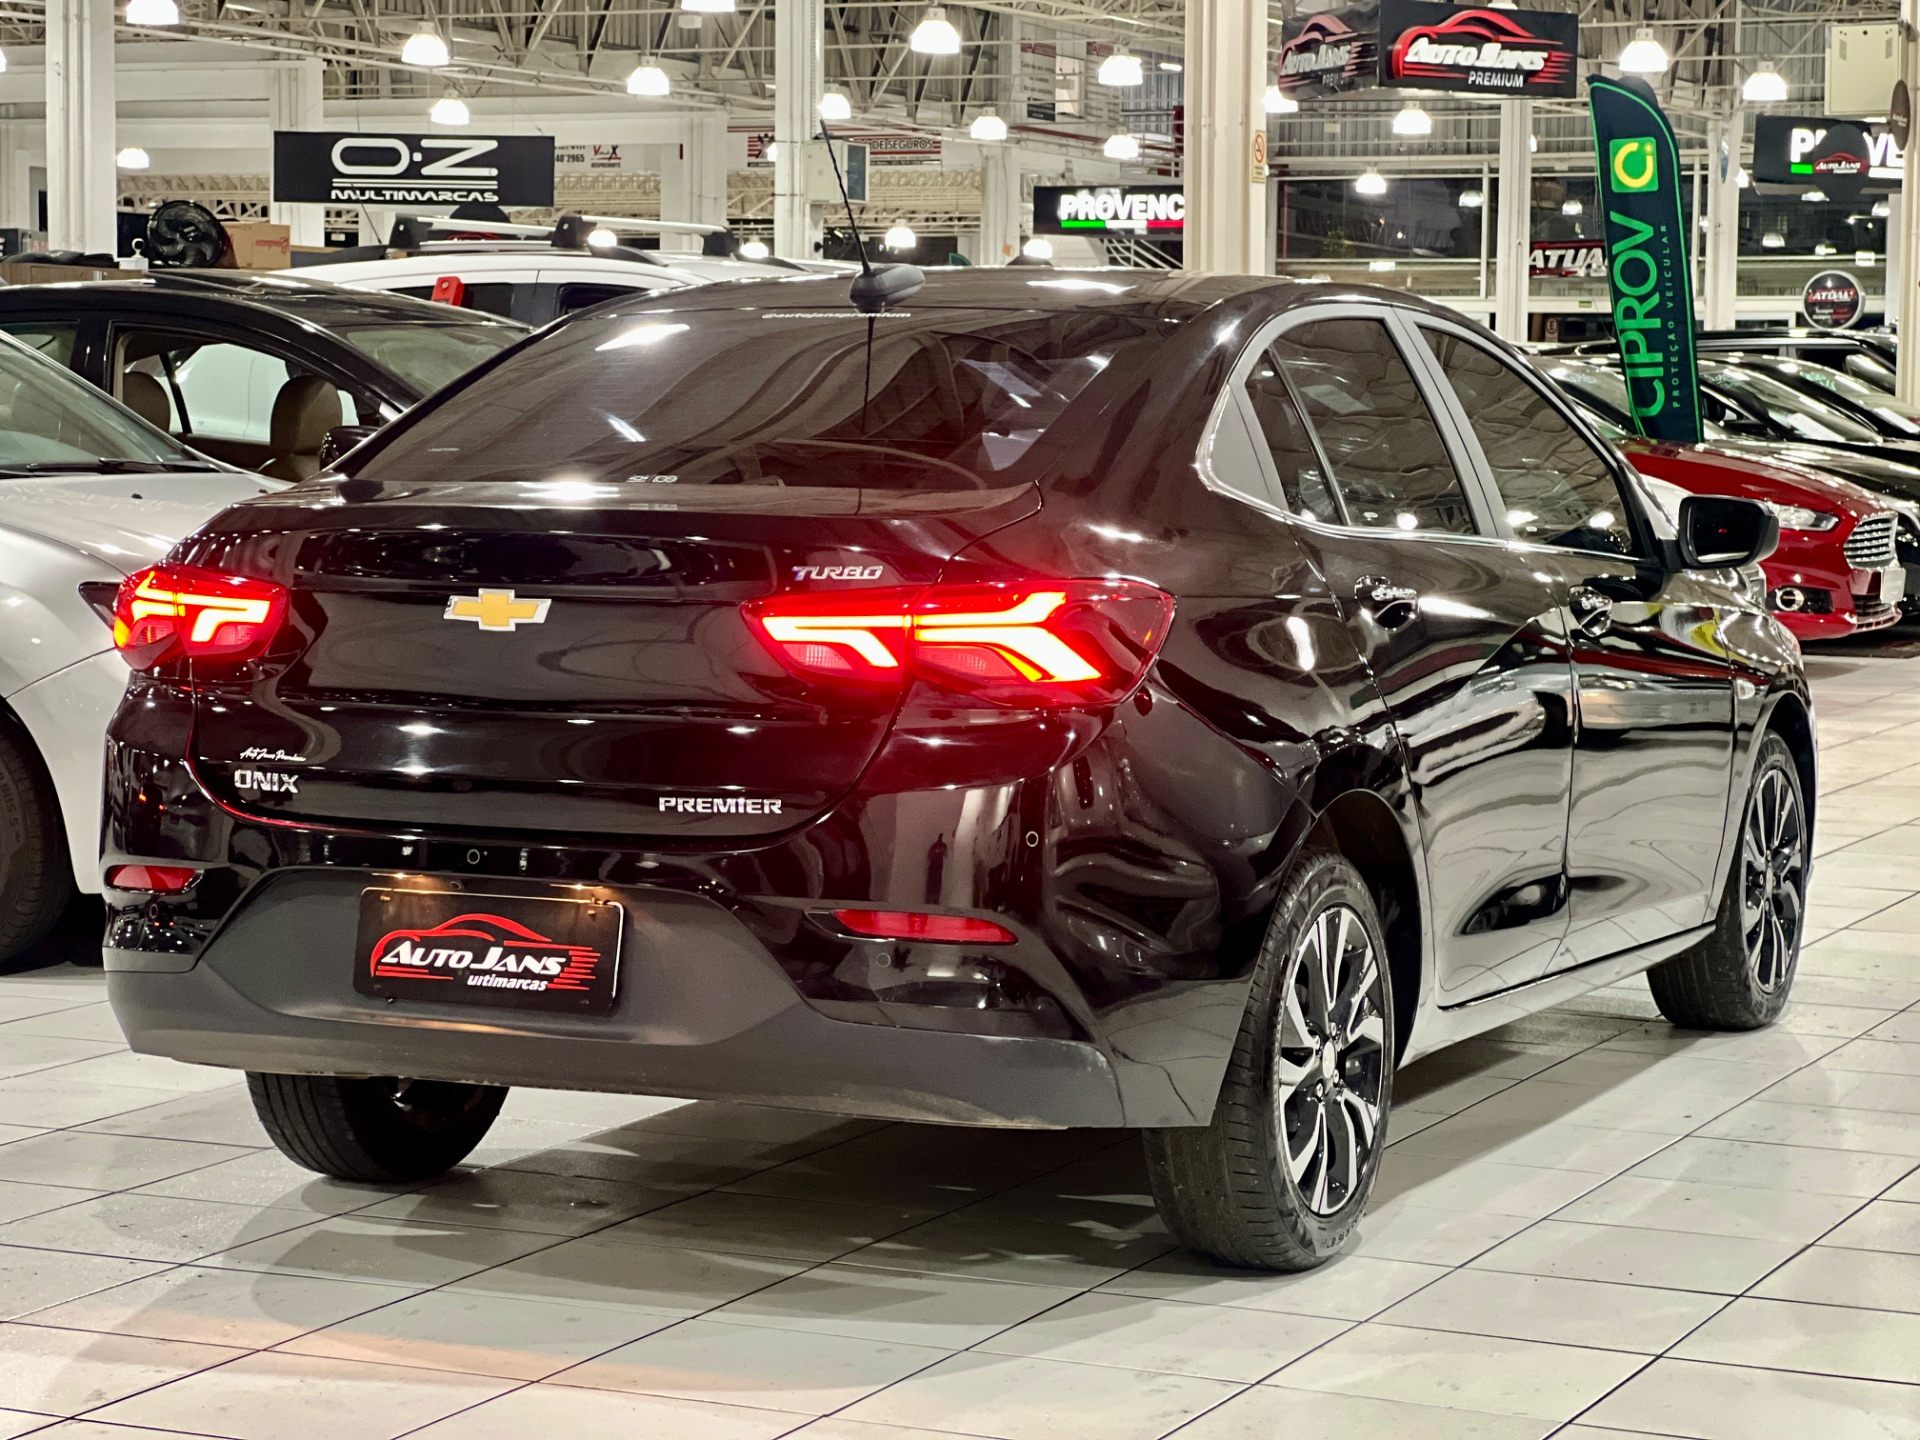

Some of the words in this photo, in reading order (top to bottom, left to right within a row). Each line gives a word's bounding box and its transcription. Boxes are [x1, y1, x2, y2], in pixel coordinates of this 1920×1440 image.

[1468, 71, 1523, 88] PREMIUM
[331, 189, 498, 202] MULTIMARCAS
[1529, 248, 1608, 273] ATUA
[1660, 225, 1674, 308] VEICULAR
[1610, 211, 1665, 417] CIPROV
[1668, 321, 1680, 407] PROTEÇÃO
[791, 565, 883, 581] TURBO
[234, 768, 299, 793] ONIX
[659, 797, 782, 814] PREMIER
